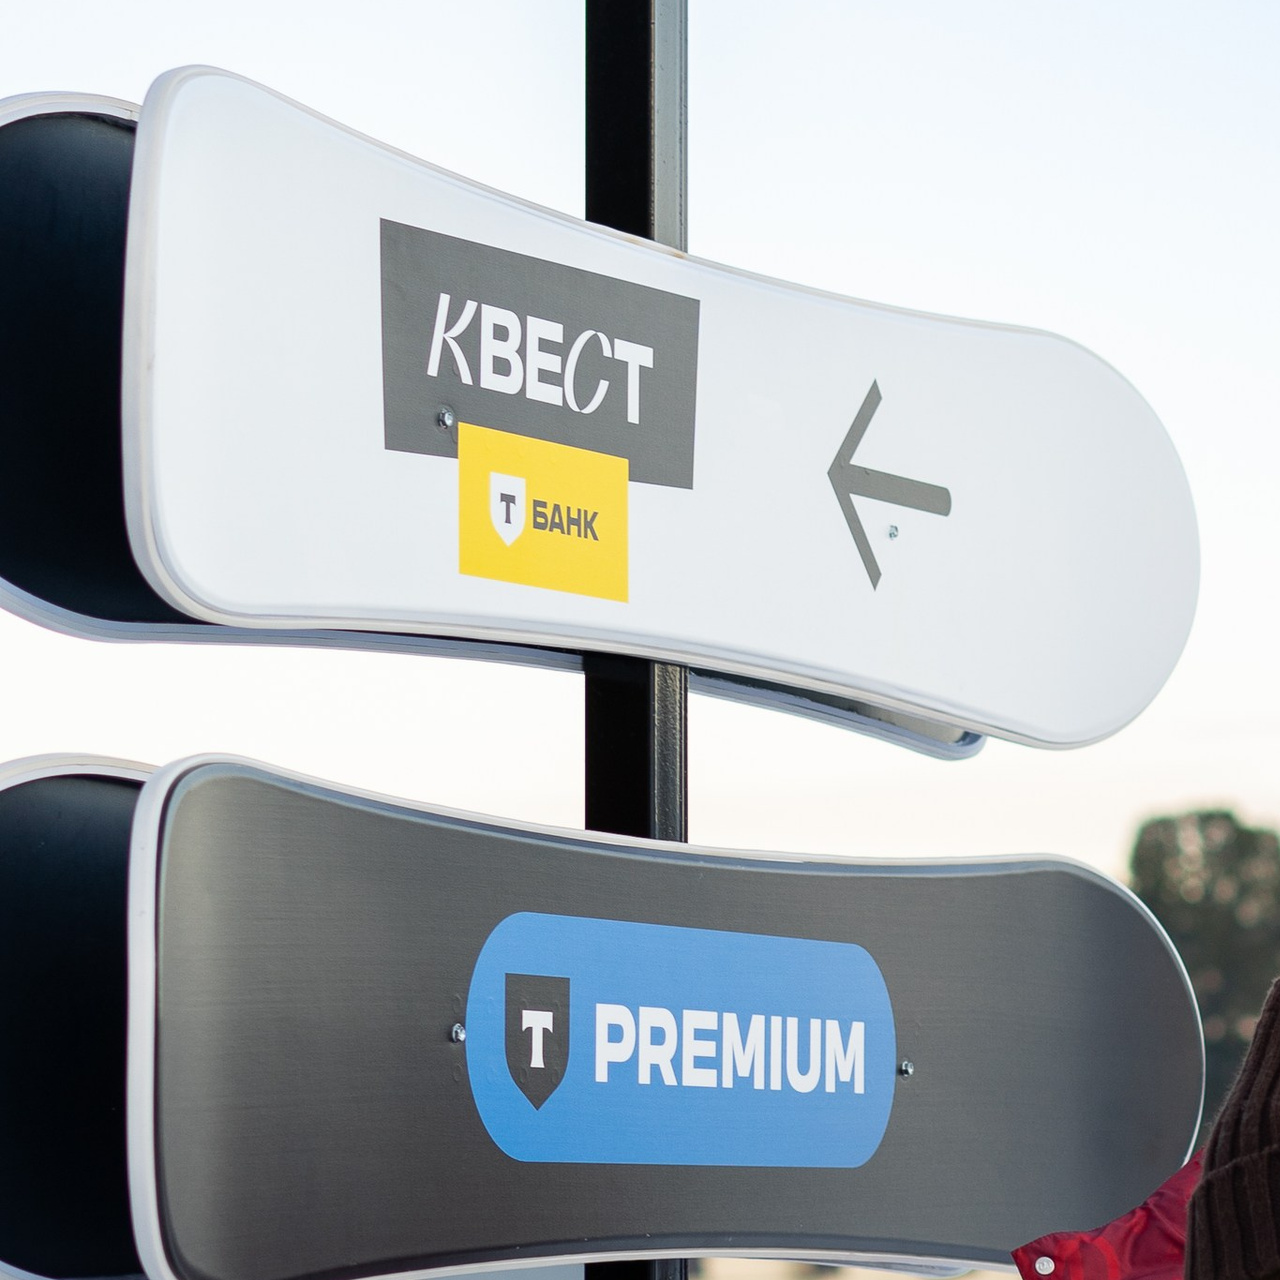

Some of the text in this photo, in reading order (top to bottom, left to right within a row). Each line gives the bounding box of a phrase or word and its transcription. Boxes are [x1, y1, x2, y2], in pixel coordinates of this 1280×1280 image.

[427, 292, 654, 425] КВЕСТ
[532, 499, 600, 542] БАНК
[521, 1003, 866, 1096] T PREMIUM
